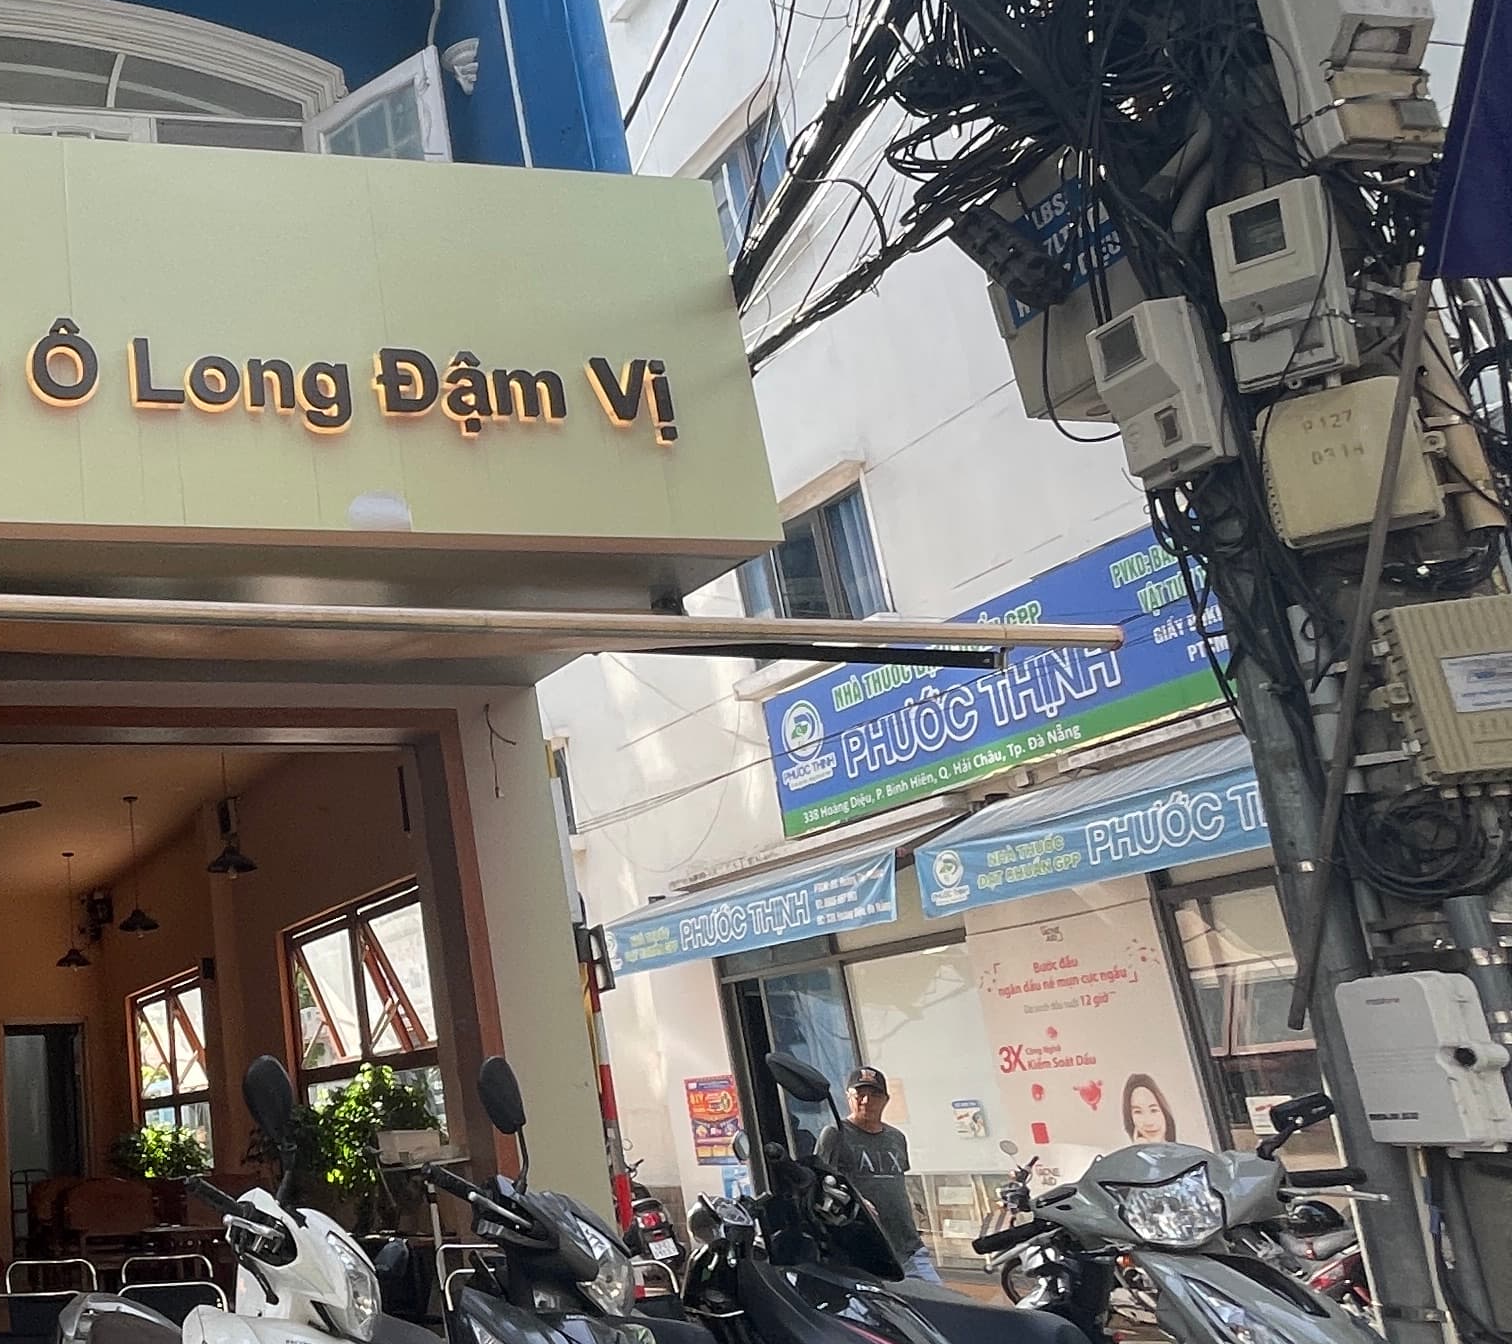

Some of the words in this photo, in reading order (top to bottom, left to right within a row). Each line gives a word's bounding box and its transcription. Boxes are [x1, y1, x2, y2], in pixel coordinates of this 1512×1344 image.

[25, 316, 99, 408] Ô
[127, 336, 355, 433] Long
[373, 345, 567, 438] Đậm
[587, 355, 681, 444] Vị
[831, 678, 863, 713] NHÀ
[840, 684, 979, 779] PHƯỚC
[976, 646, 1123, 728] THỊNH
[803, 809, 820, 825] 338
[819, 801, 850, 824] Hoàng
[851, 793, 876, 813] Diệu,
[875, 786, 886, 801] P.
[909, 771, 938, 792] Hiên,
[938, 765, 950, 782] Q.
[952, 757, 973, 776] Hải
[972, 749, 1007, 771] Châu,
[1006, 741, 1027, 763] Tp.
[1027, 733, 1046, 751] Đà
[1046, 723, 1082, 748] Nẵng
[1085, 790, 1226, 865] PHƯỚC
[1052, 851, 1082, 872] GPP
[679, 905, 747, 951] PHƯỚC
[745, 889, 811, 937] THỊNH
[1079, 994, 1093, 1008] 12
[998, 1043, 1028, 1075] 3X
